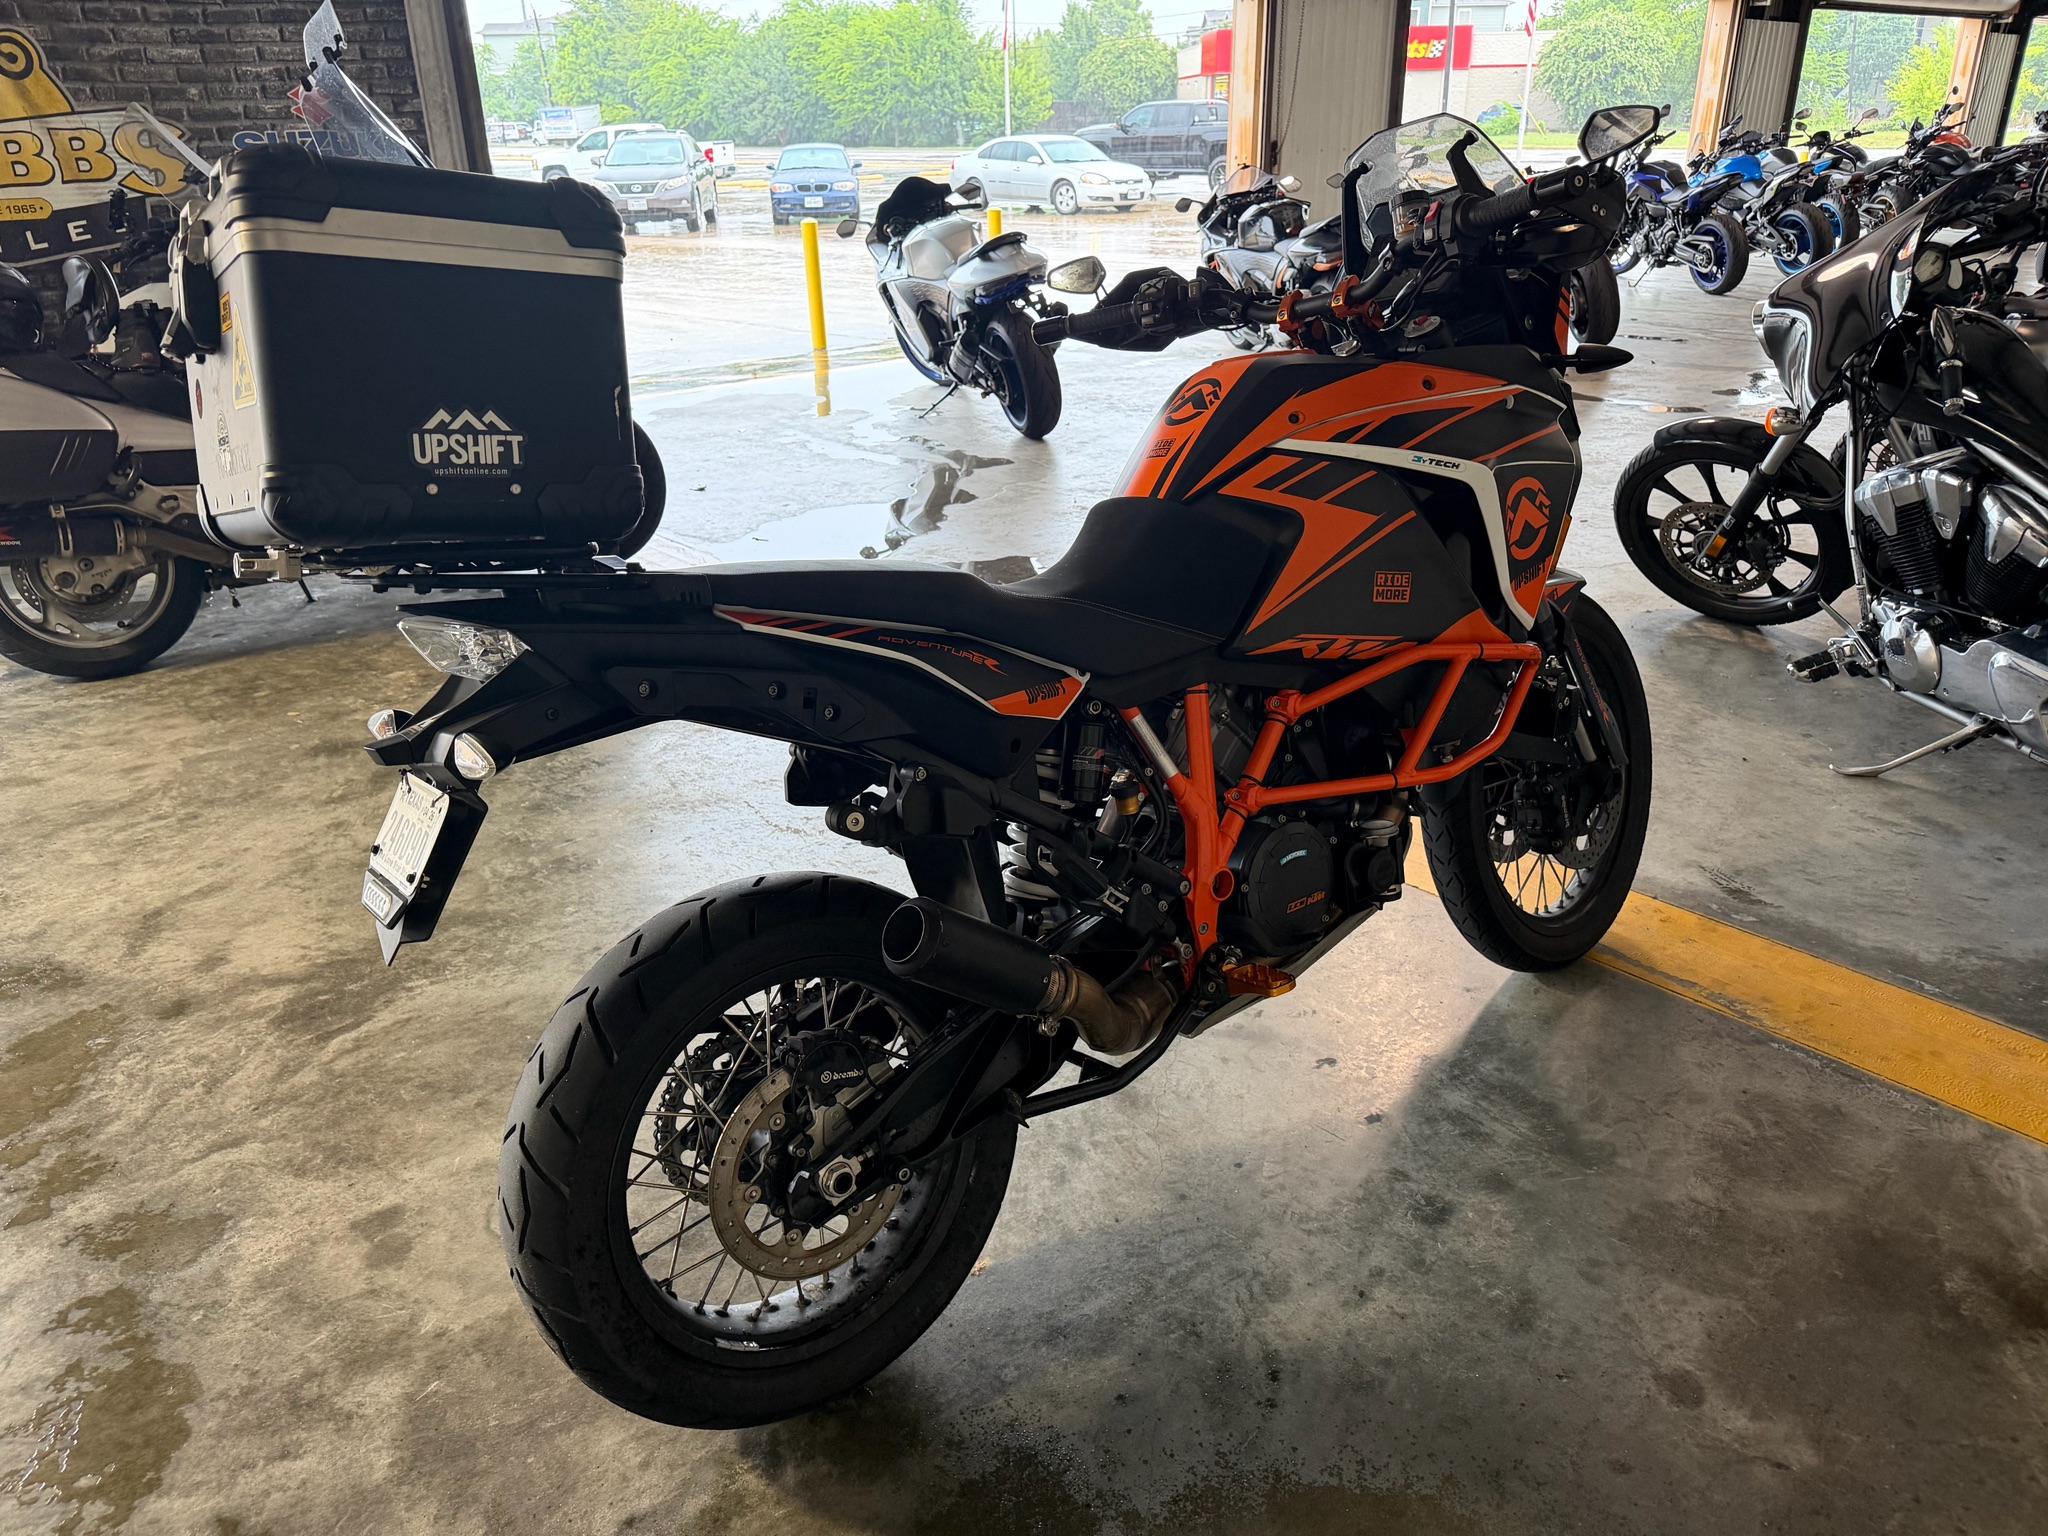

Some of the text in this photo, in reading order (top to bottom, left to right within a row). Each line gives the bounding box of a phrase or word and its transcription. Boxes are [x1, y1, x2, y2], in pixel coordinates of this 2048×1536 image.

[5, 204, 37, 214] 1965
[412, 433, 523, 465] UPSHIFT
[1149, 448, 1169, 456] MORE
[434, 466, 509, 477] upshiftonline.com
[1377, 573, 1410, 586] RIDE
[1514, 561, 1547, 591] UPSHIFT
[1375, 588, 1409, 600] MORE
[1024, 679, 1067, 705] UPSHIFT
[380, 809, 431, 871] 246D9D
[832, 1068, 864, 1080] brembo
